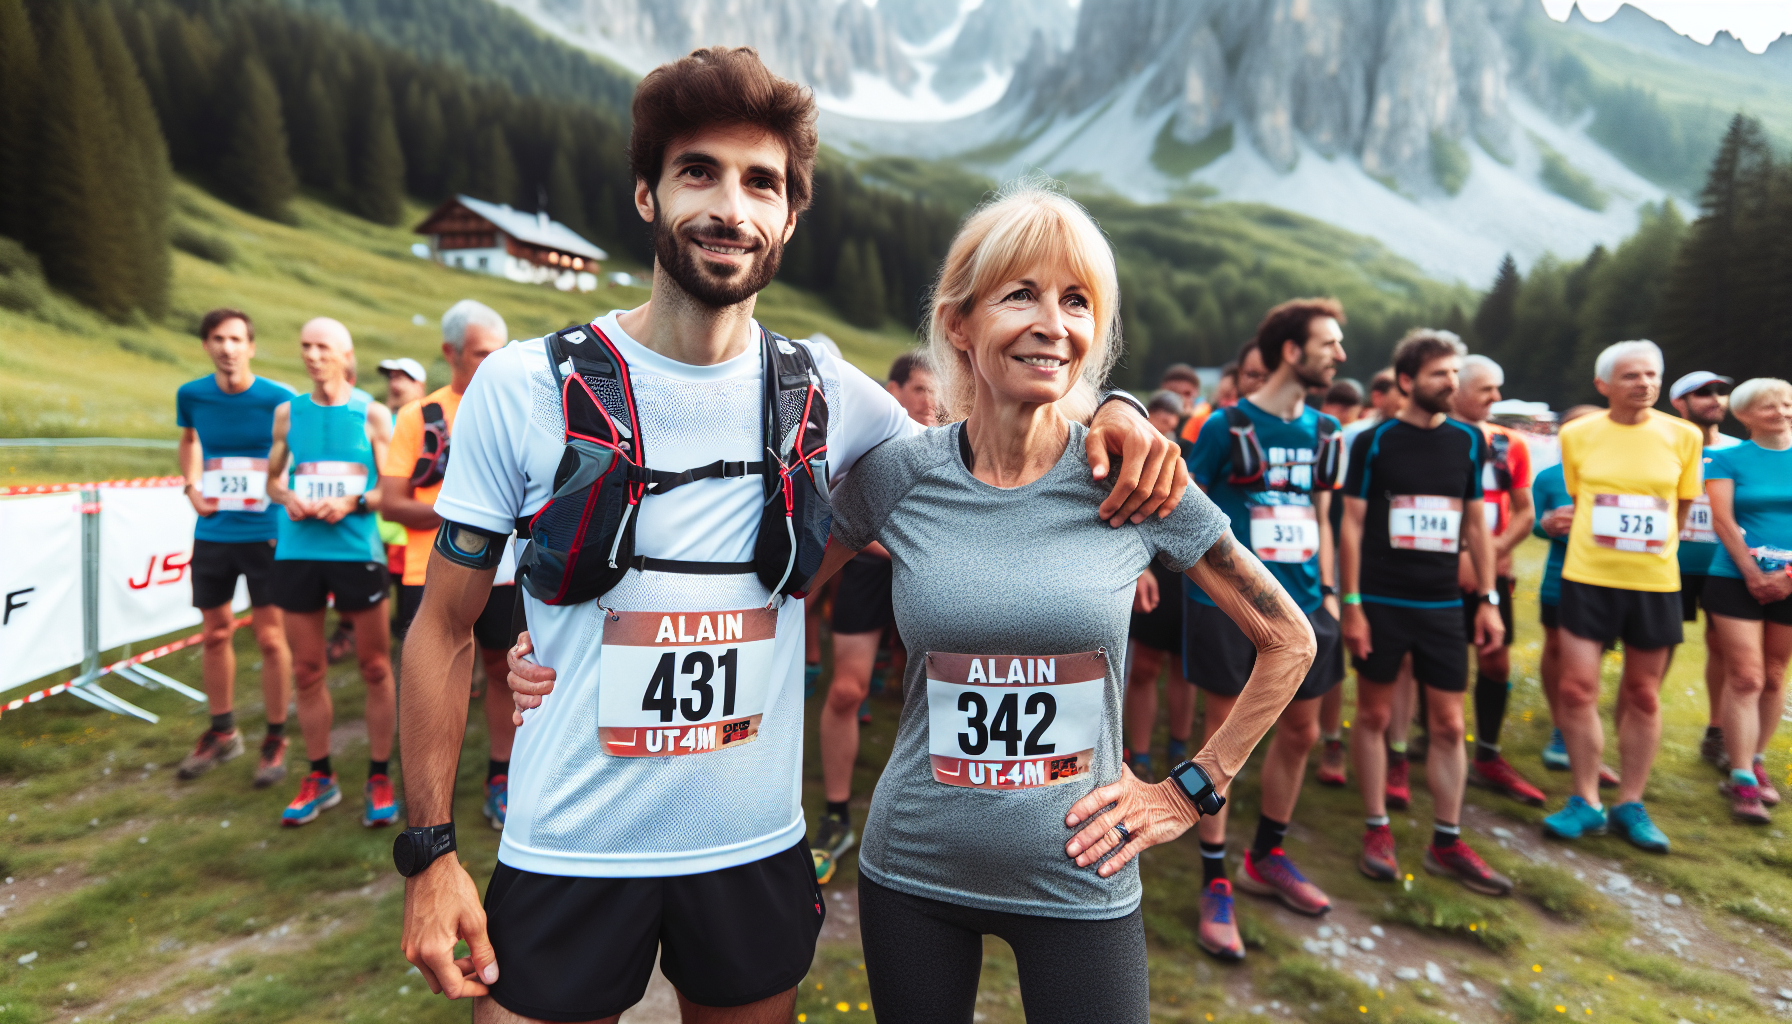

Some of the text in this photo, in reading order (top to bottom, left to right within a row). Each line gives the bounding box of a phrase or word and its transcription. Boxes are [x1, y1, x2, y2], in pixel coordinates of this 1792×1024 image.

[4, 587, 35, 625] F
[655, 613, 743, 643] ALAIN
[642, 648, 738, 723] 431
[967, 658, 1056, 684] ALAIN
[957, 692, 1057, 757] 342
